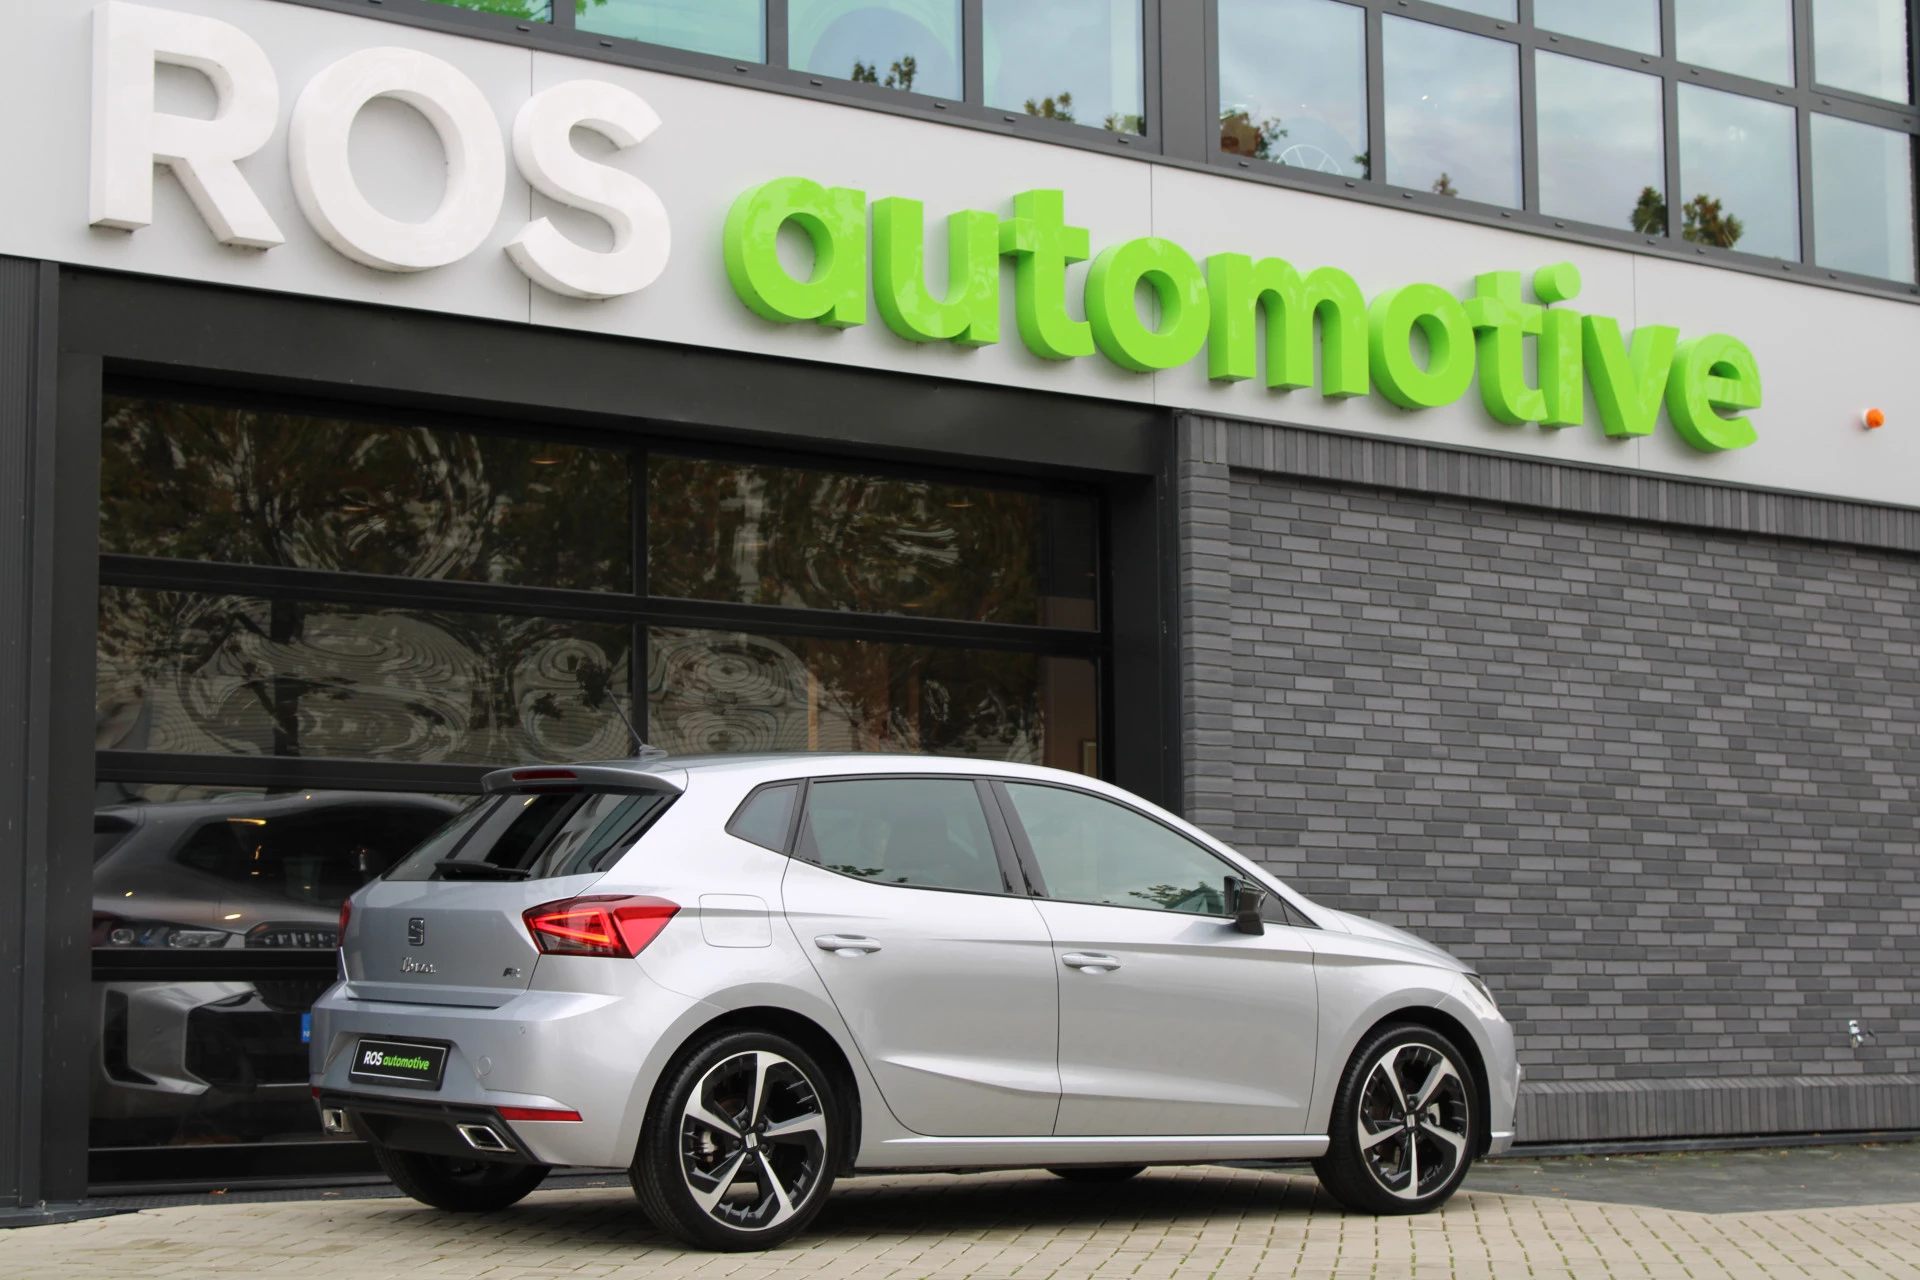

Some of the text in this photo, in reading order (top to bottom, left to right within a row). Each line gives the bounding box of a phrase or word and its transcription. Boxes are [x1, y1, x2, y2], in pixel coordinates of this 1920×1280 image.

[89, 0, 1762, 453] ROS automotive
[363, 1051, 430, 1070] ROS automotive
